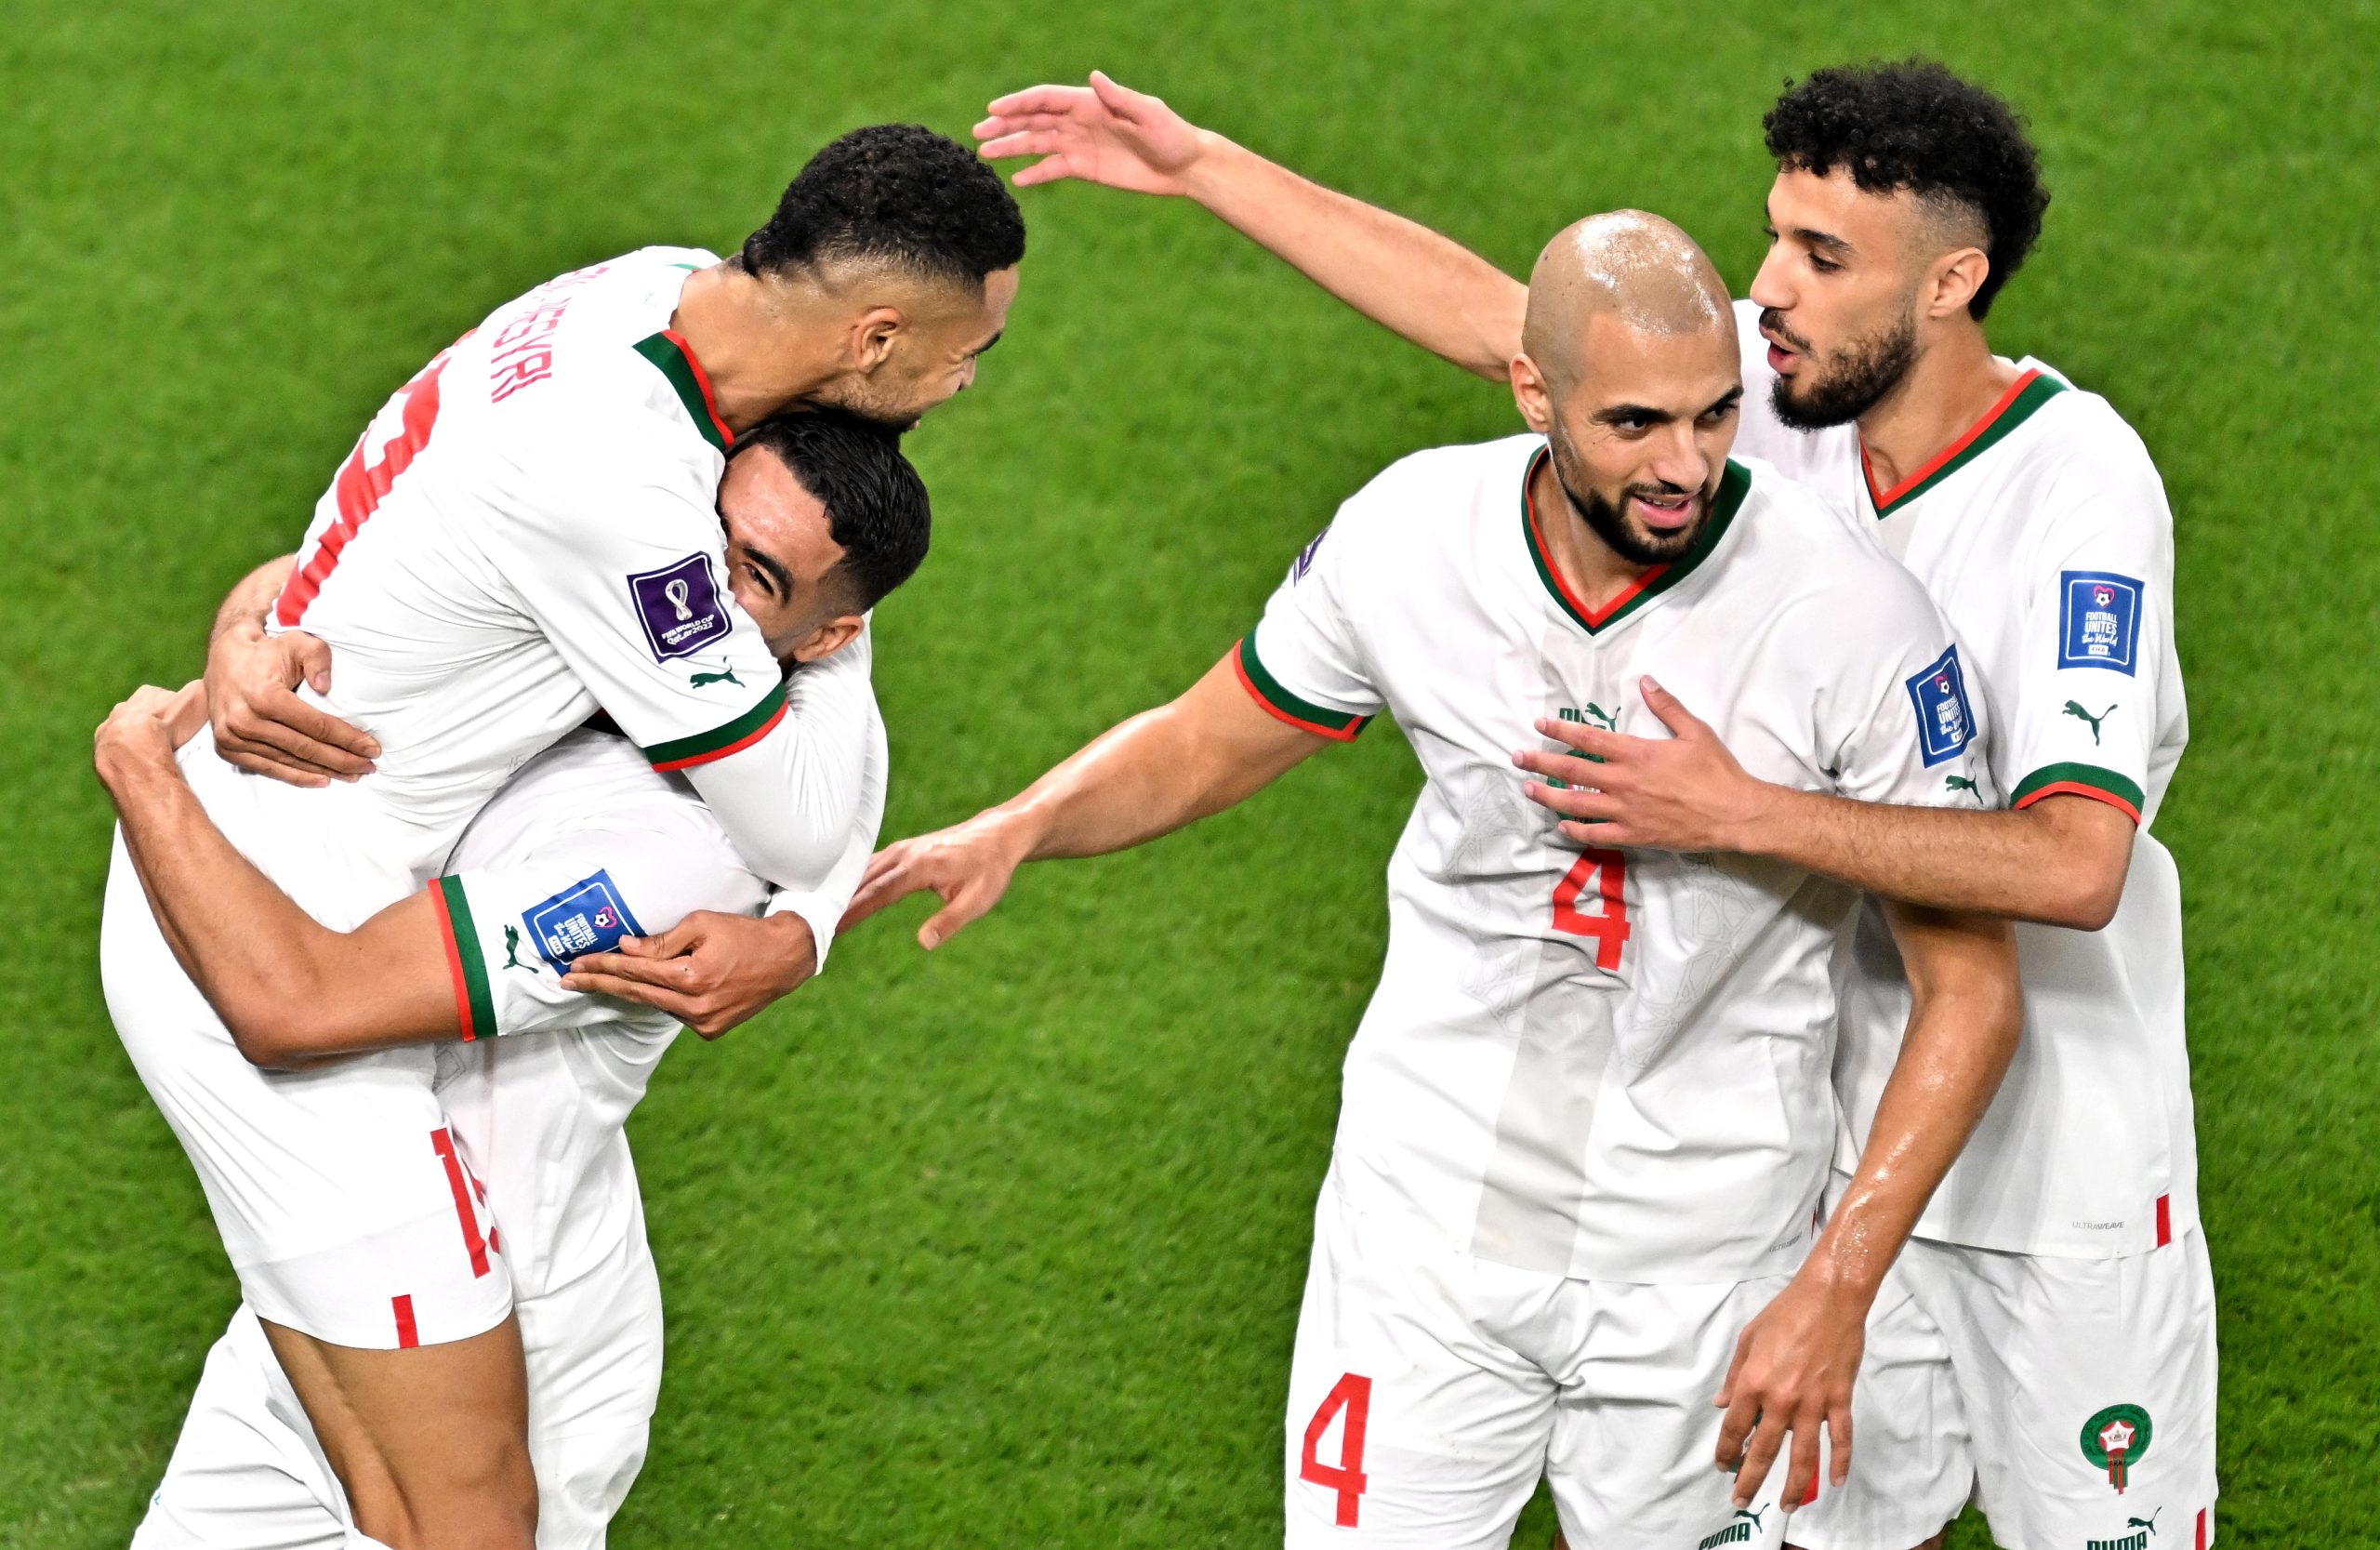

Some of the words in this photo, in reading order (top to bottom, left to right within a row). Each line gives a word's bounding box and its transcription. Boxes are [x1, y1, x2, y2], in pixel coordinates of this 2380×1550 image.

[675, 620, 701, 632] WORLD
[701, 614, 714, 624] CUP
[2084, 621, 2117, 635] UNITES
[2086, 611, 2117, 624] FOOTBALL
[2082, 633, 2095, 643] the
[2095, 632, 2118, 646] World
[1940, 723, 1953, 735] the
[1553, 847, 1631, 971] 4
[564, 917, 590, 948] UNITES
[575, 912, 599, 944] FOOTBALL
[430, 1128, 500, 1278] 1
[2072, 1221, 2124, 1230] ULTRAWEAVE
[1299, 1371, 1373, 1529] 4
[1699, 1522, 1751, 1550] PUMA
